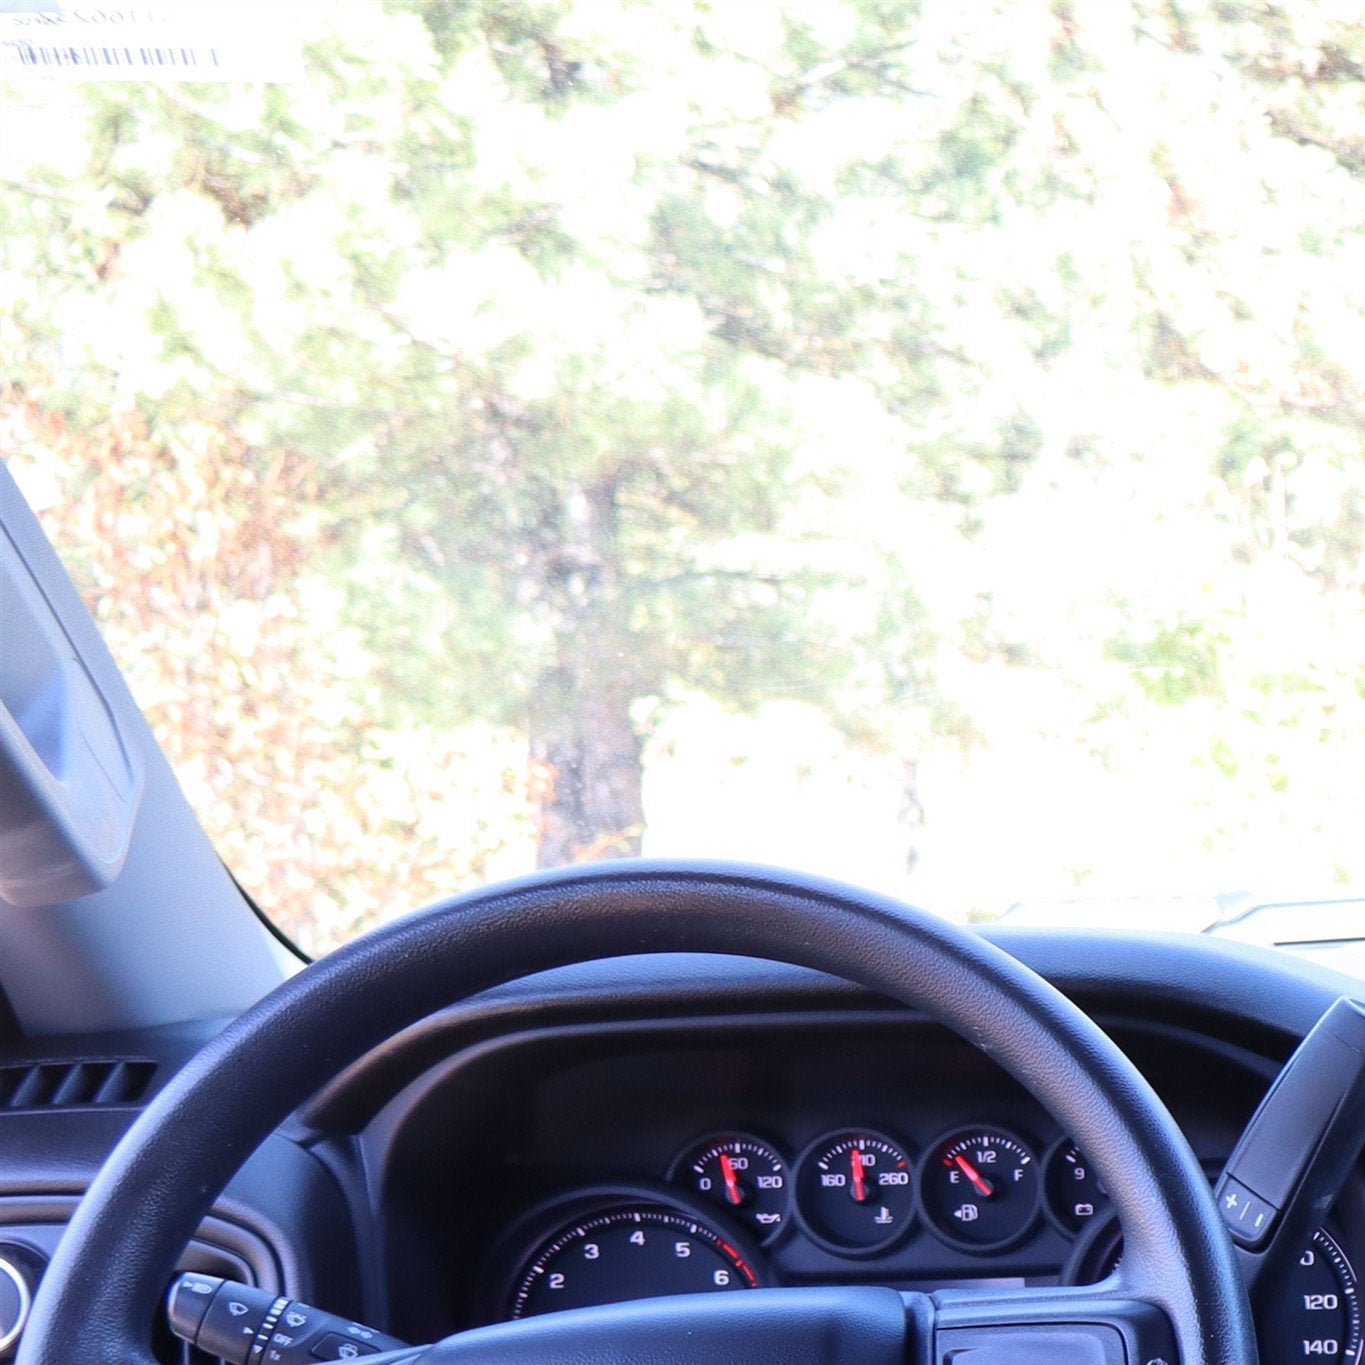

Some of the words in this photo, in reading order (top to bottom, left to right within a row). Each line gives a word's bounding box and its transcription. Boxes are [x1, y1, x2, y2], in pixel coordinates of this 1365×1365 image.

[976, 1150, 997, 1163] 1/2
[820, 1174, 846, 1187] 160
[878, 1172, 909, 1185] 260
[950, 1171, 960, 1183] E
[1014, 1169, 1023, 1181] F
[1074, 1167, 1085, 1180] 9
[757, 1175, 783, 1188] 120
[629, 1231, 646, 1246] 4
[584, 1243, 600, 1260] 3
[674, 1242, 691, 1257] 5
[549, 1273, 565, 1289] 2
[713, 1269, 730, 1286] 6
[1303, 1294, 1338, 1310] 120
[1303, 1339, 1338, 1355] 140
